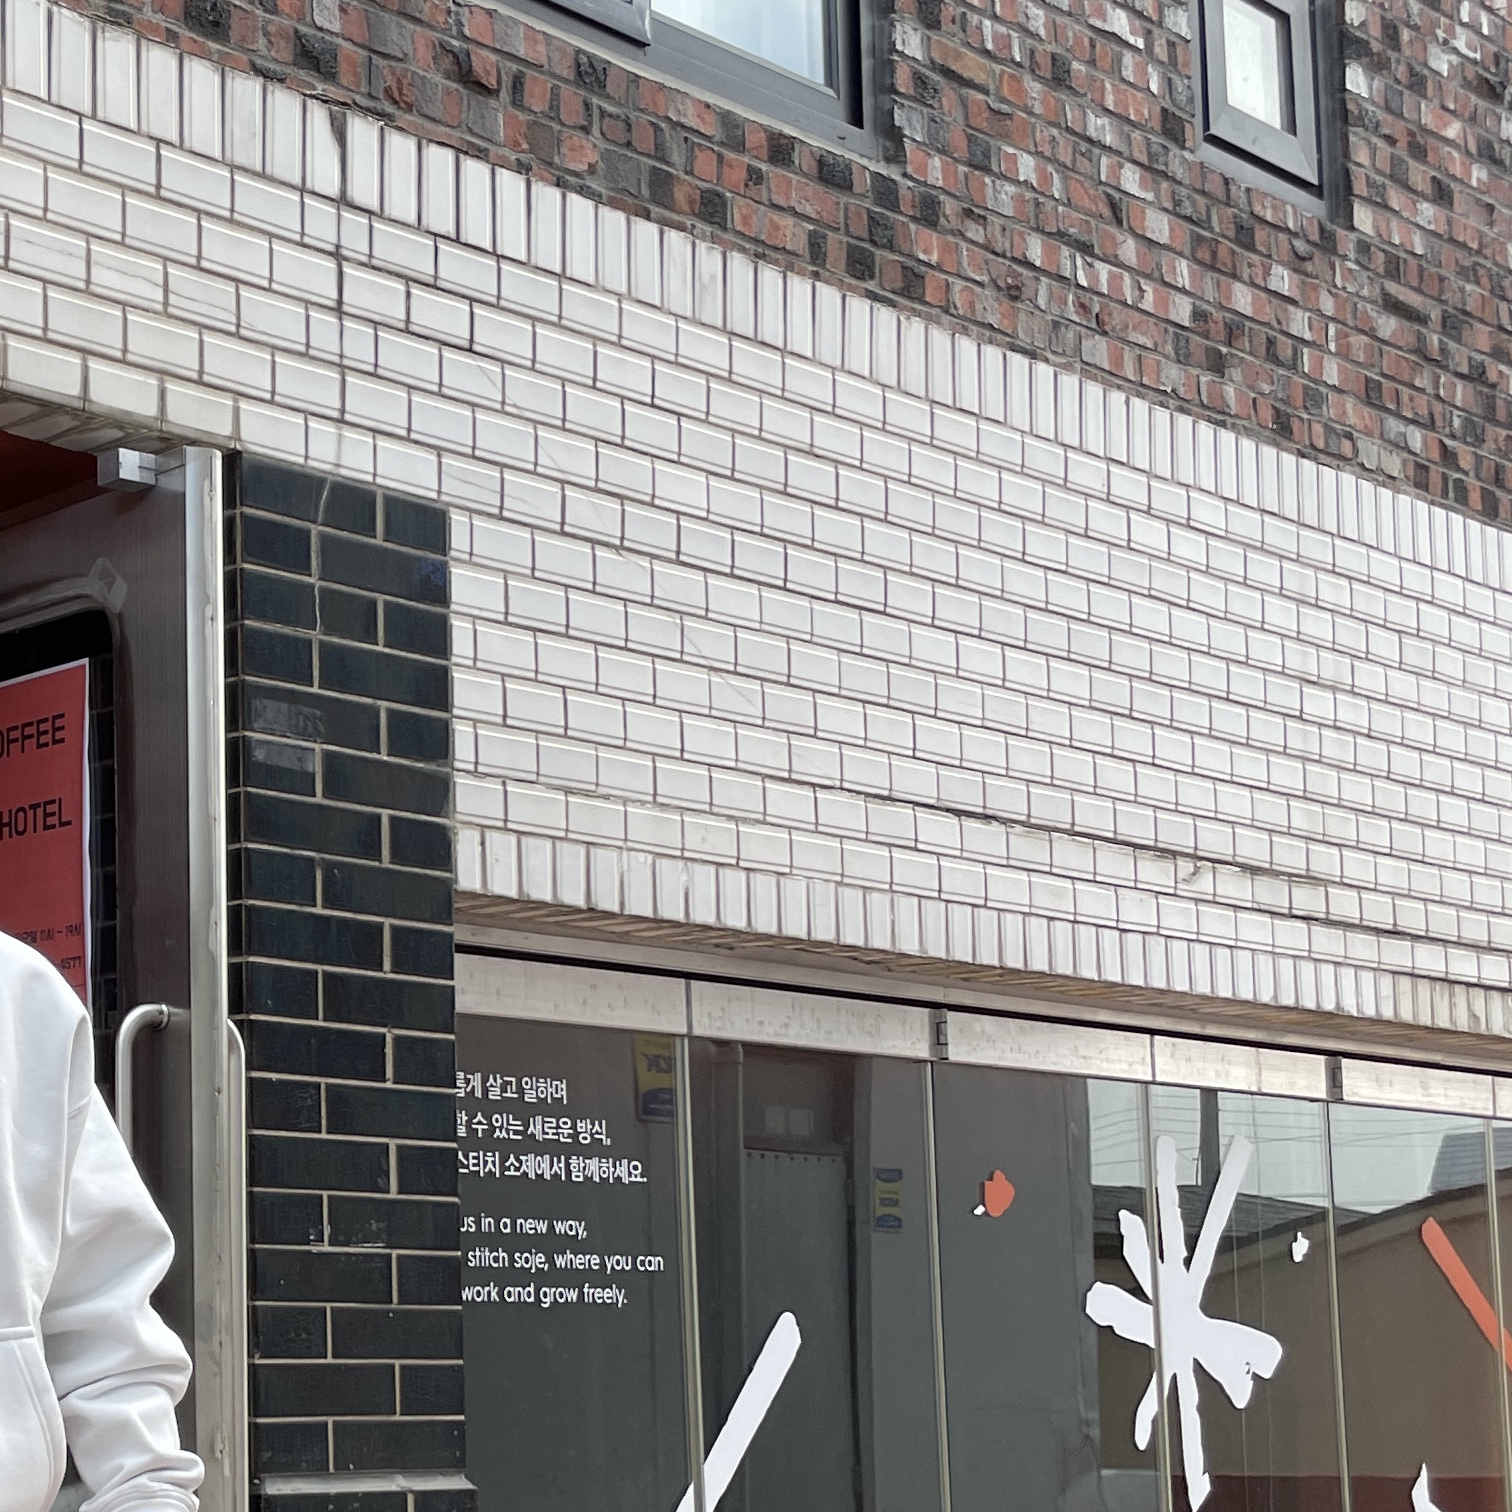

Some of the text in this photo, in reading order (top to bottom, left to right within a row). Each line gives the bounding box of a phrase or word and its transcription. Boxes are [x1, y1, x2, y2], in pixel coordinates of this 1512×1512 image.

[486, 1073, 518, 1100] 살고
[521, 1076, 567, 1105] 일하며
[471, 1112, 489, 1138] 수
[491, 1112, 524, 1140] 있는
[527, 1115, 574, 1143] 새로운
[504, 1153, 566, 1182] 소제에서
[569, 1155, 647, 1184] 함께하세요.
[480, 1212, 495, 1234] in
[499, 1217, 511, 1234] a
[516, 1217, 549, 1234] new
[553, 1220, 587, 1240] way,
[467, 1246, 664, 1275] stitch soje, where you can
[461, 1281, 628, 1308] work and grow freely.
